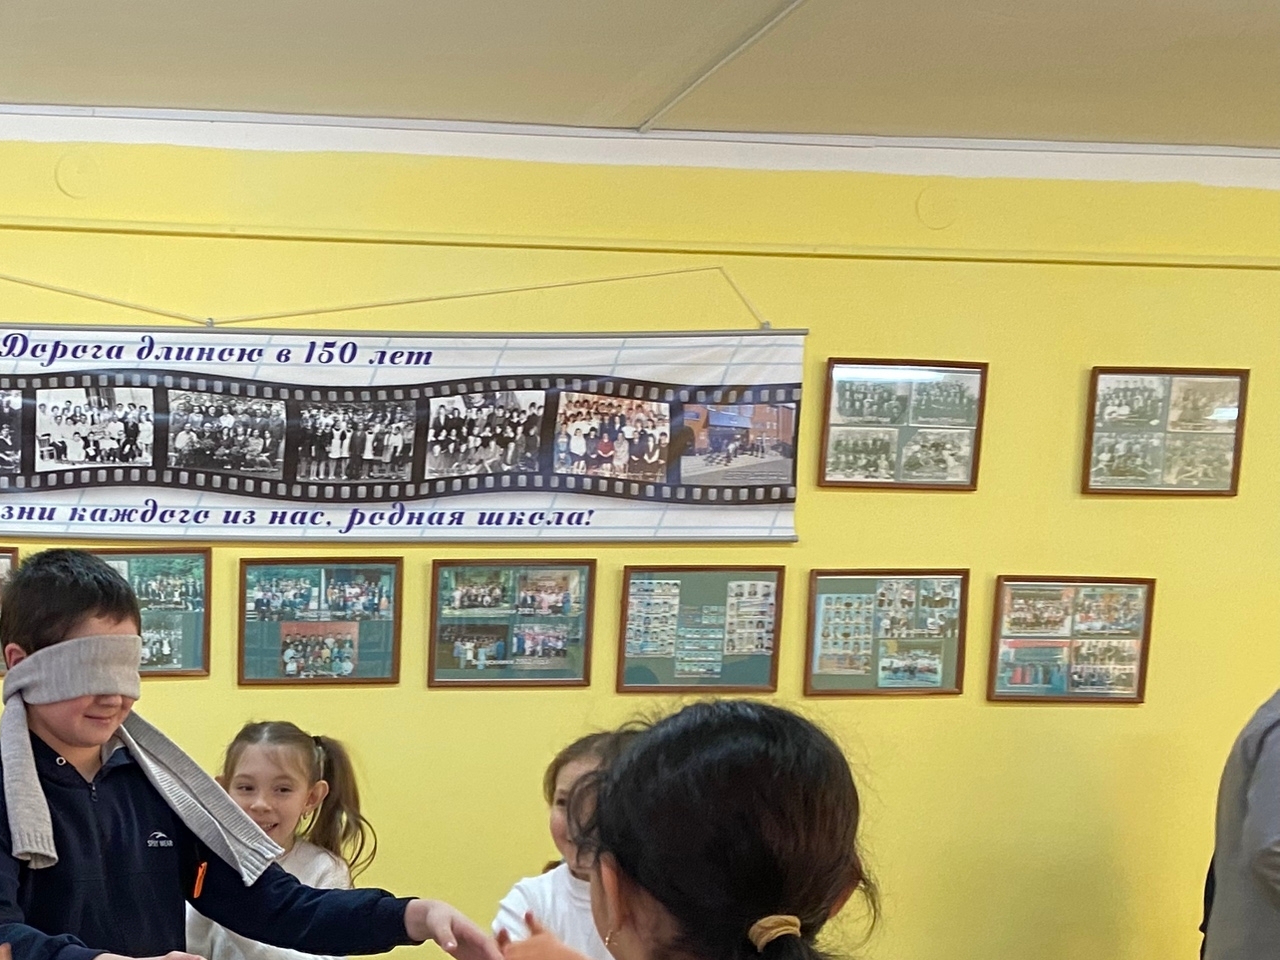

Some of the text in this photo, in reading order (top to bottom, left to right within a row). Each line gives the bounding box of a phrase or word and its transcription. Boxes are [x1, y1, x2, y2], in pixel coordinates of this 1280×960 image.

[136, 335, 264, 363] длиною
[276, 348, 292, 363] в
[304, 340, 359, 365] 150
[368, 349, 434, 366] лет
[67, 498, 211, 525] каждого
[222, 509, 257, 526] из
[268, 509, 333, 528] нас,
[337, 502, 466, 534] родная
[477, 509, 596, 527] школа!
